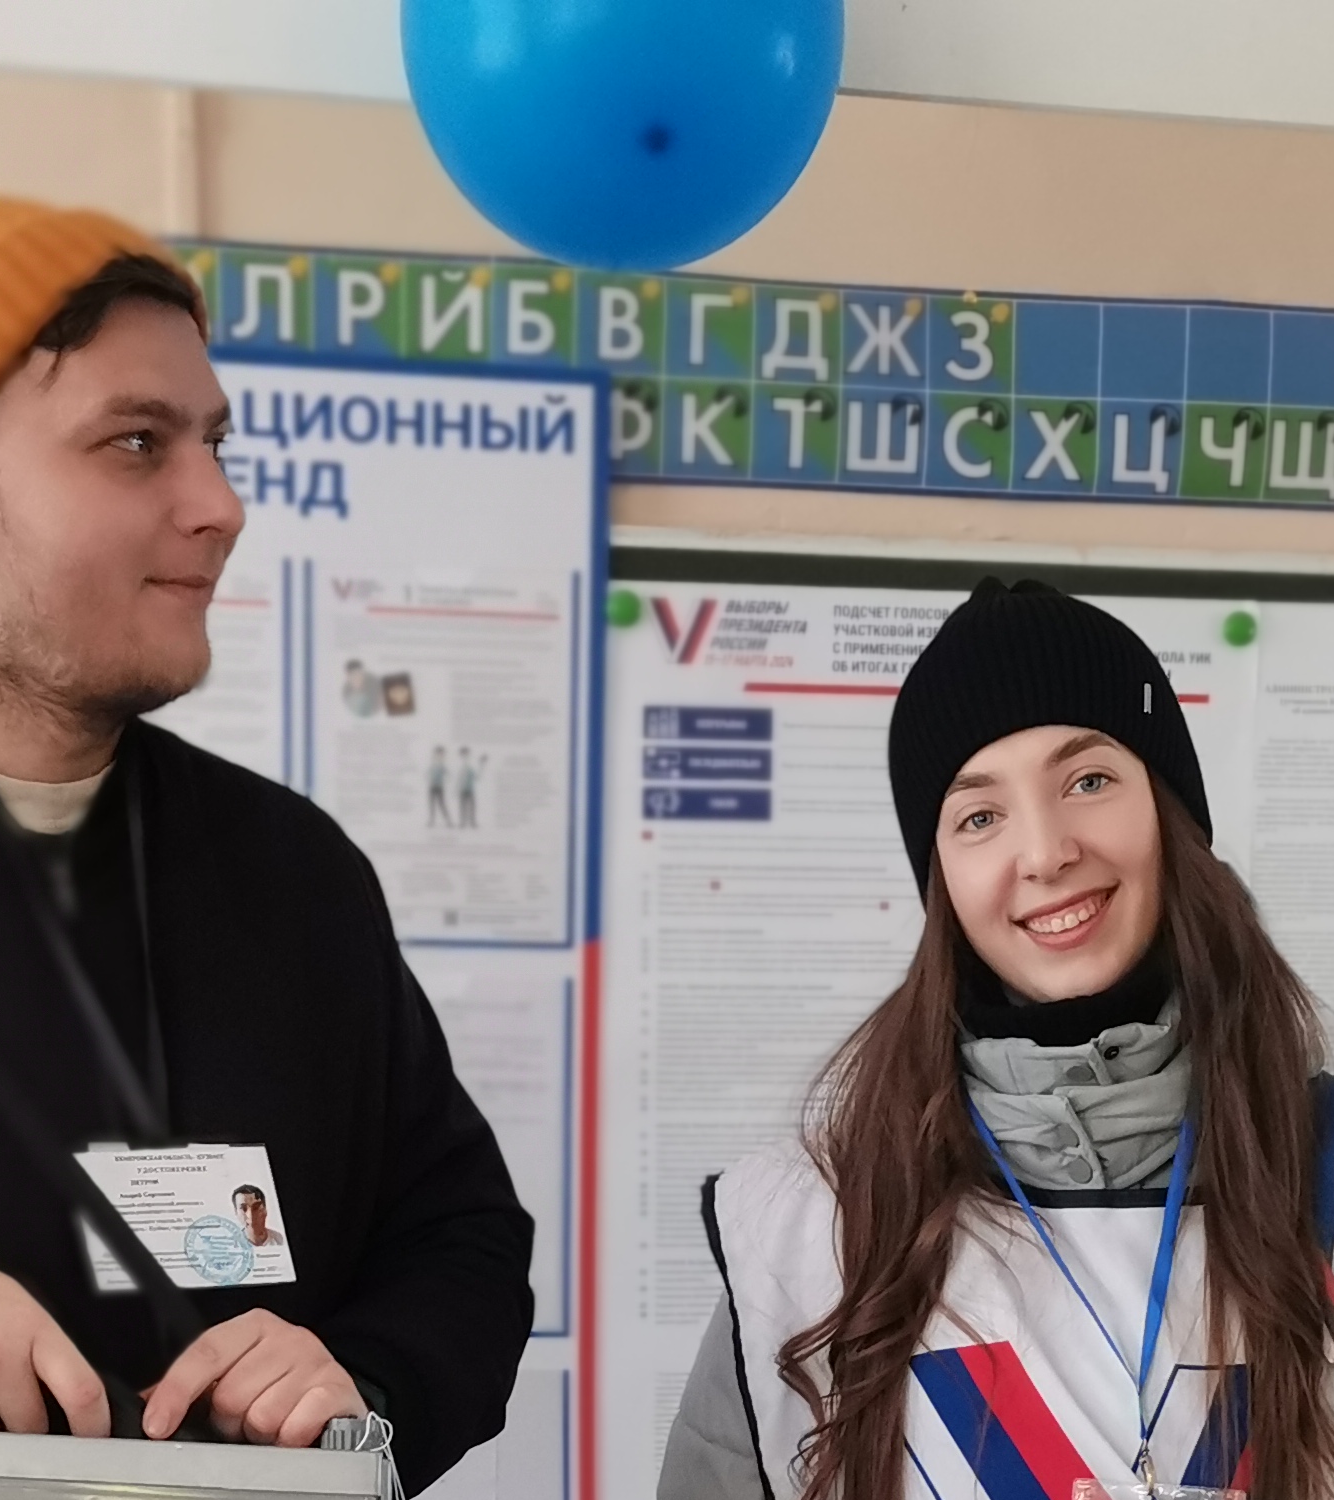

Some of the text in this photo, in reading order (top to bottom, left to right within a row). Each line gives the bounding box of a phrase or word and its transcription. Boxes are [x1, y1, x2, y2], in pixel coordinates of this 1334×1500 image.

[230, 262, 295, 342] Л
[334, 268, 386, 349] Р
[419, 268, 485, 354] Й
[505, 278, 557, 355] Б
[597, 285, 645, 361] В
[761, 298, 830, 383] Д
[847, 302, 921, 379] Ж
[229, 388, 576, 457] ЦИОННЫЙ
[724, 599, 790, 615] ВЫБОРЫ
[832, 604, 891, 620] ПОДСЧЕТ
[717, 617, 808, 635] ПРЕЗИДЕНТА
[833, 622, 914, 638] УЧАСТКОВОЙ
